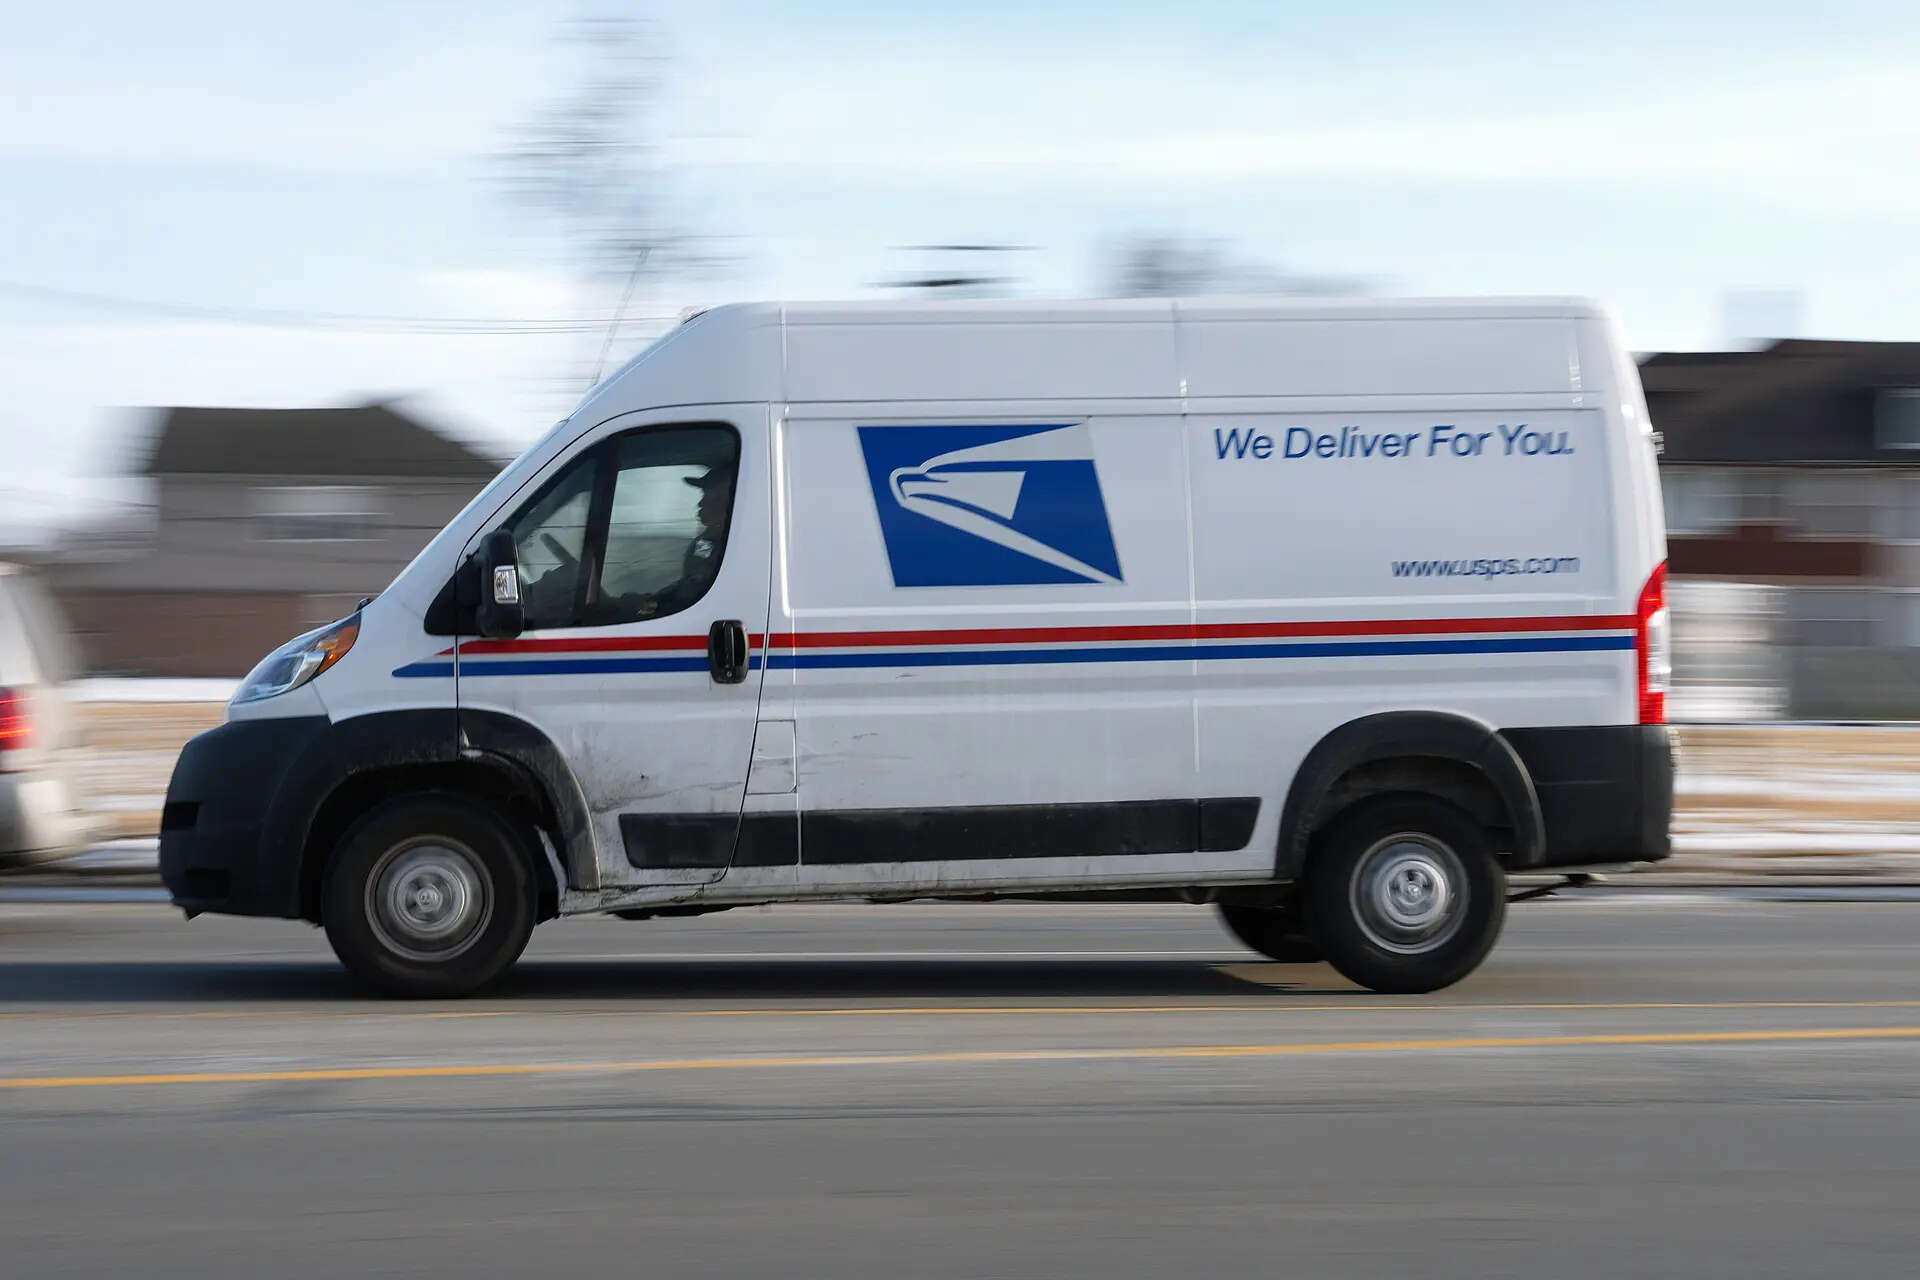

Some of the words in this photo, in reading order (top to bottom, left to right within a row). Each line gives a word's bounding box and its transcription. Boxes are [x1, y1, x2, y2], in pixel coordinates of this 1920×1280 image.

[1214, 427, 1274, 459] We
[1282, 425, 1420, 458] Deliver
[1427, 424, 1491, 456] For
[1498, 423, 1575, 456] You.
[1392, 557, 1579, 581] www.usps.com
